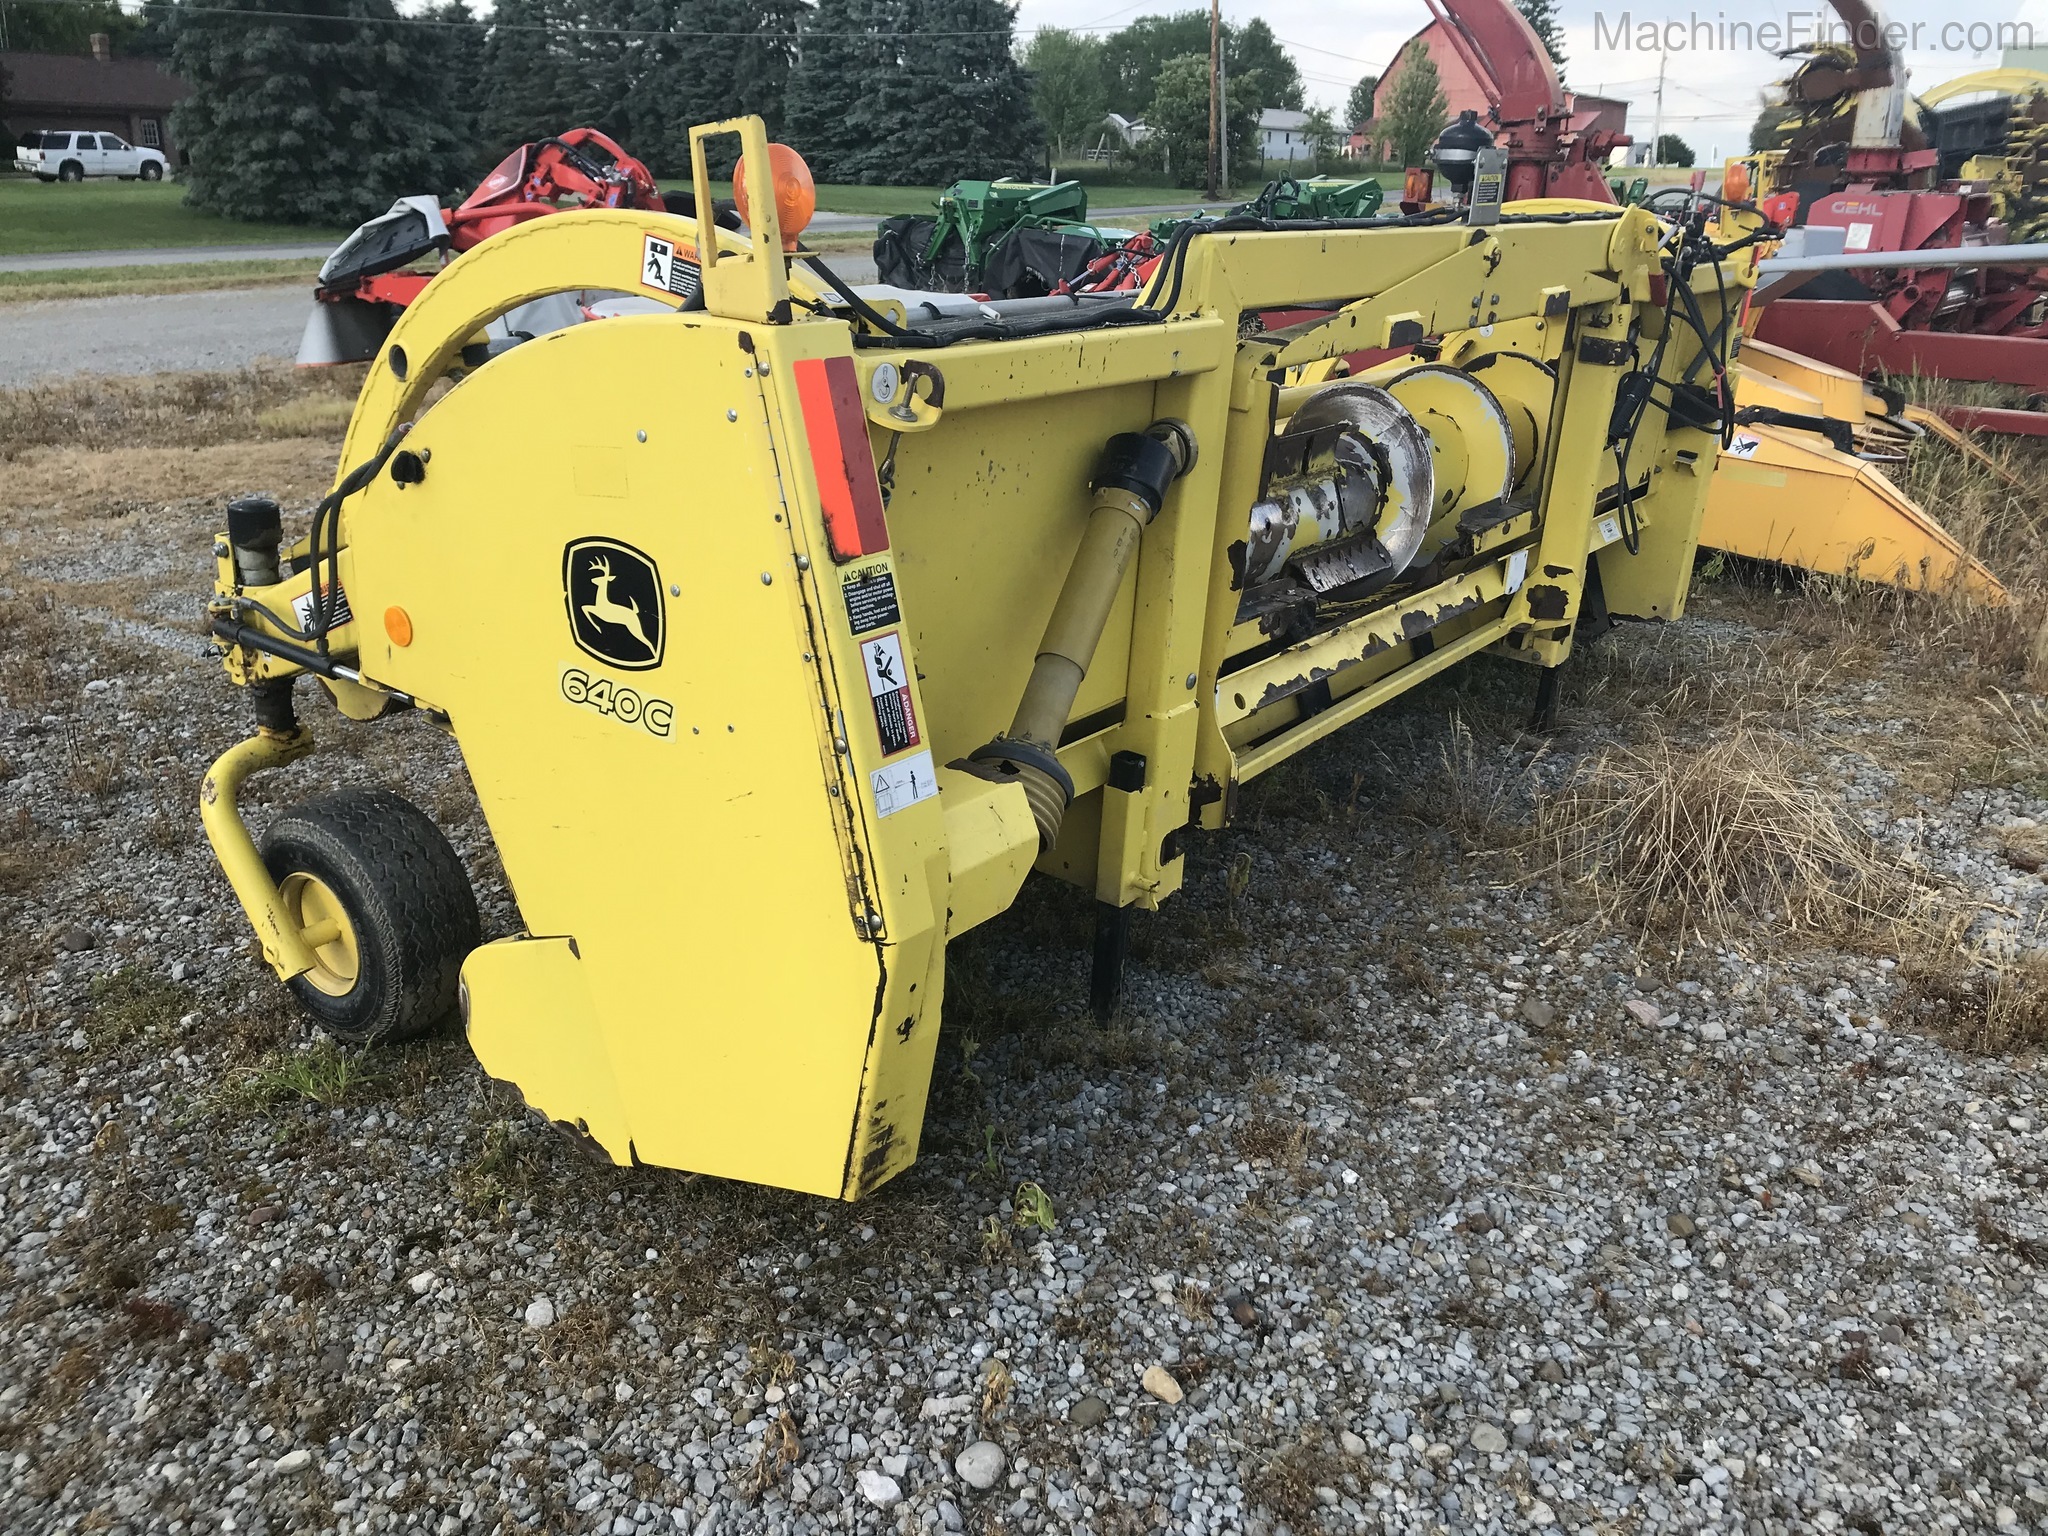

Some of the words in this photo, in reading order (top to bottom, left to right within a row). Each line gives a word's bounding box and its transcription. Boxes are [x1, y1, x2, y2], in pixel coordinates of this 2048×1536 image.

[1831, 201, 1883, 216] GEHL
[850, 562, 888, 580] CAUTION
[562, 669, 673, 736] 640C
[903, 701, 916, 738] DANGER
